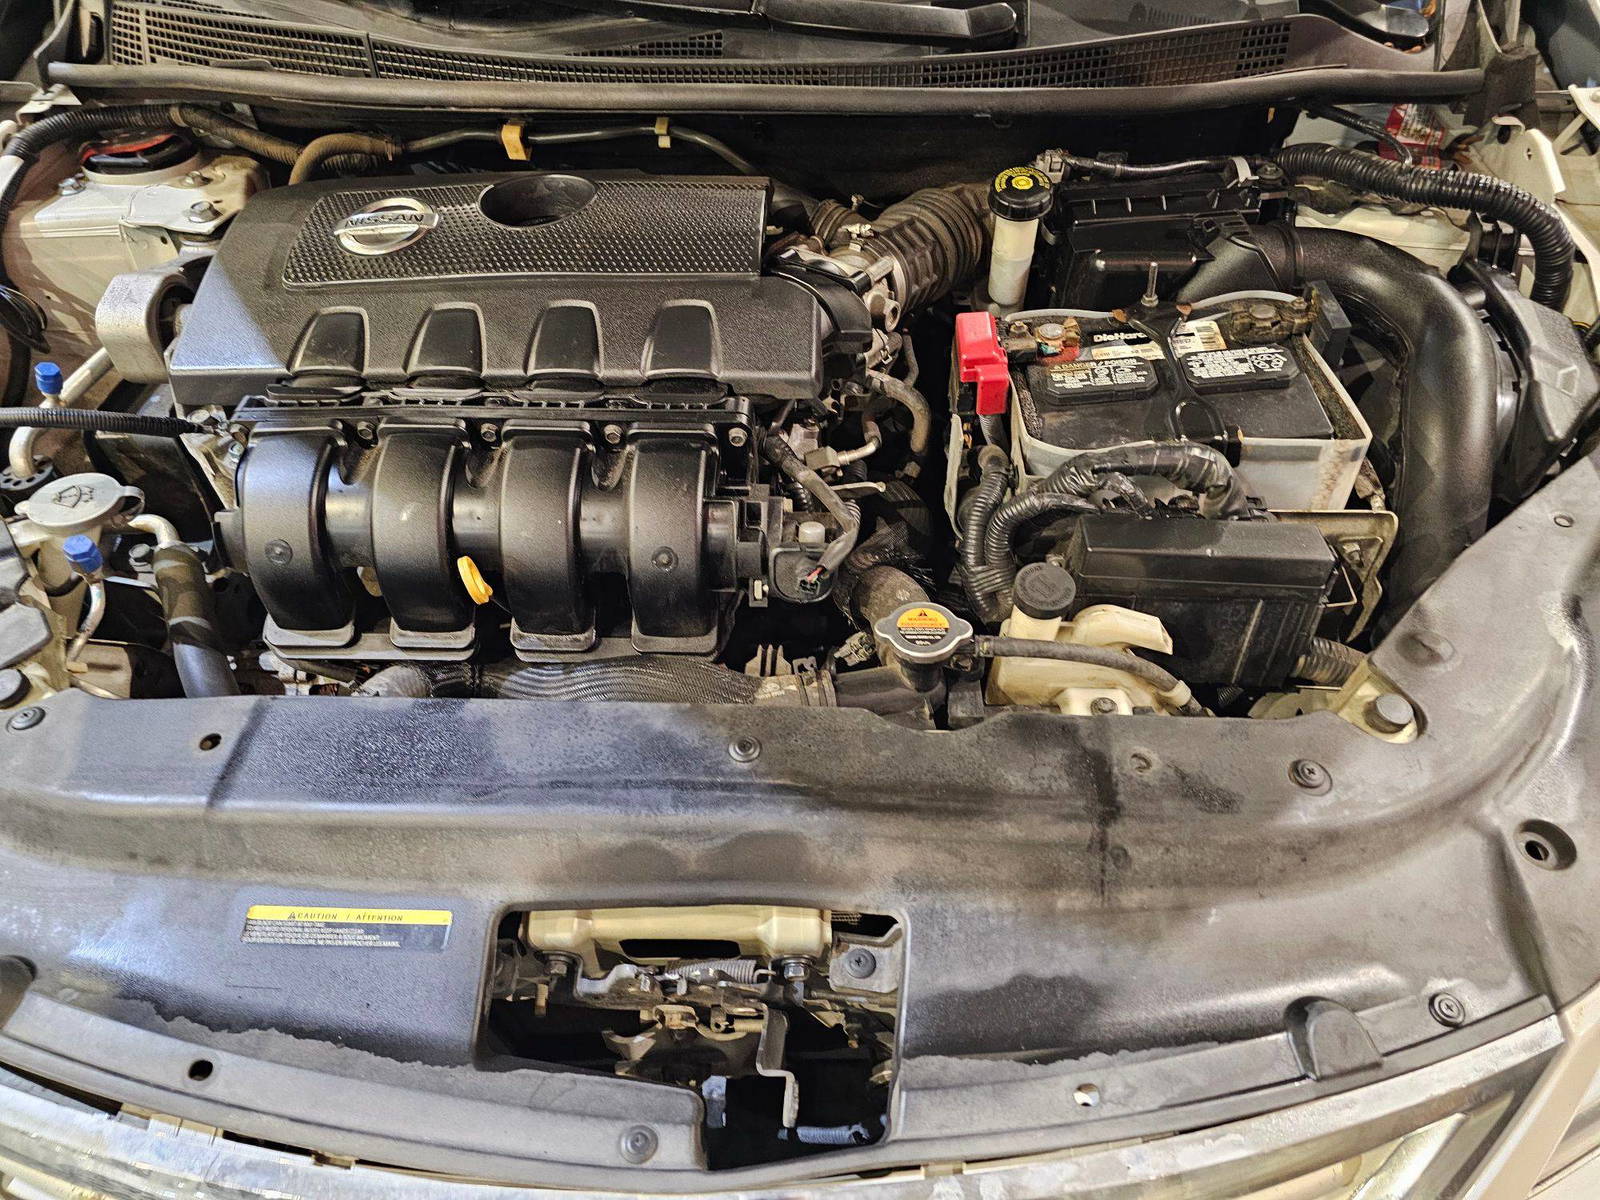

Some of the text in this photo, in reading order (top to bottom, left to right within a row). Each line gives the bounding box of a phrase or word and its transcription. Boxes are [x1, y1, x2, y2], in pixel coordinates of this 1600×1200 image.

[345, 213, 425, 228] NISSAN
[1061, 361, 1097, 370] DANGER
[1104, 358, 1137, 366] POISON
[298, 912, 338, 920] CAUTION
